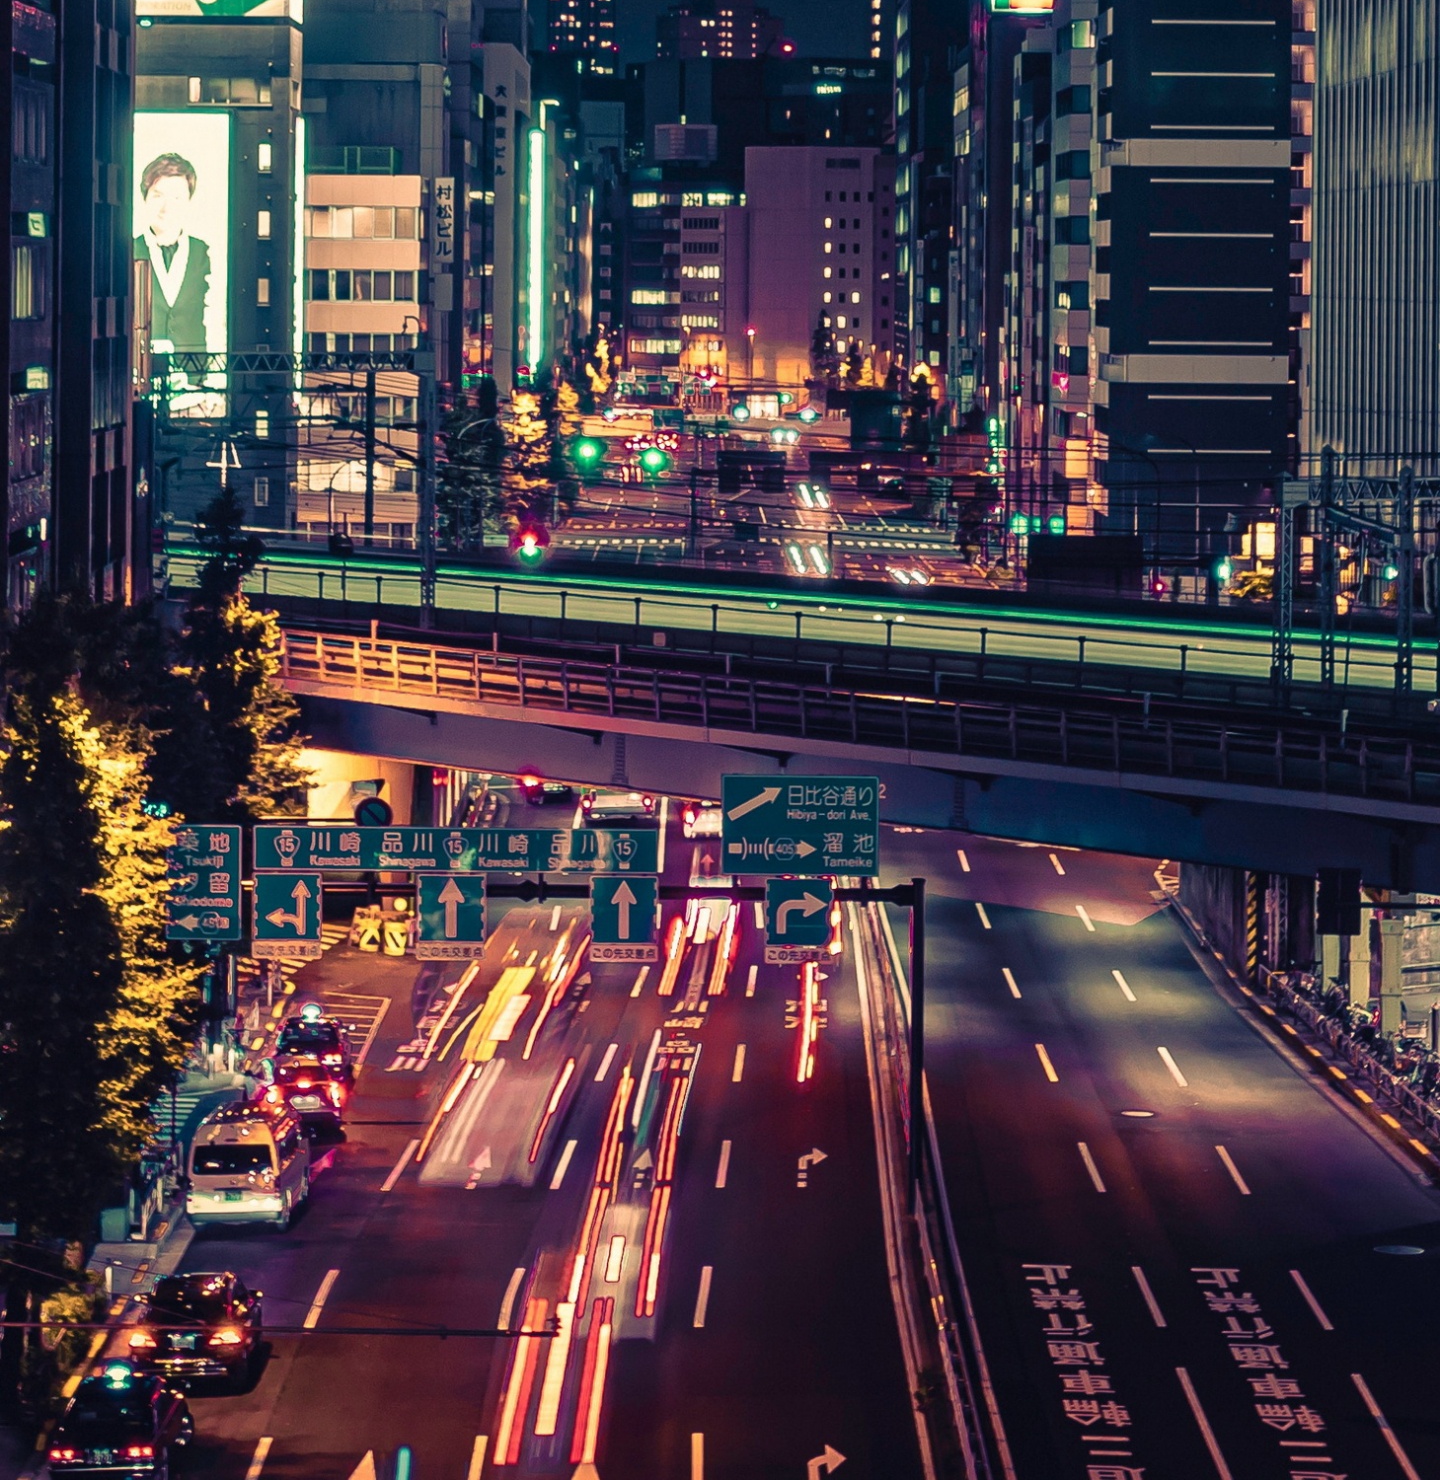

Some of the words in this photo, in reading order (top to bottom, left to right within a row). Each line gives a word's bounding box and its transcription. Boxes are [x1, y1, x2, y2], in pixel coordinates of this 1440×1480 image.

[436, 185, 452, 257] 村松ビル
[788, 785, 874, 806] 日比谷通り
[279, 838, 295, 852] 15
[310, 832, 361, 852] 川崎
[382, 832, 433, 852] 品川
[448, 839, 462, 853] 15
[479, 833, 529, 854] 川崎
[617, 842, 631, 855] 15
[823, 833, 874, 853] 溜池
[185, 855, 224, 868] Tsukiji
[310, 855, 361, 866] Kawasaki
[379, 856, 436, 869] Shinagawa
[478, 857, 529, 868] Kawasaki
[823, 856, 872, 867] Tameike
[419, 945, 483, 957] この先交差点
[593, 948, 656, 960] この先交差点
